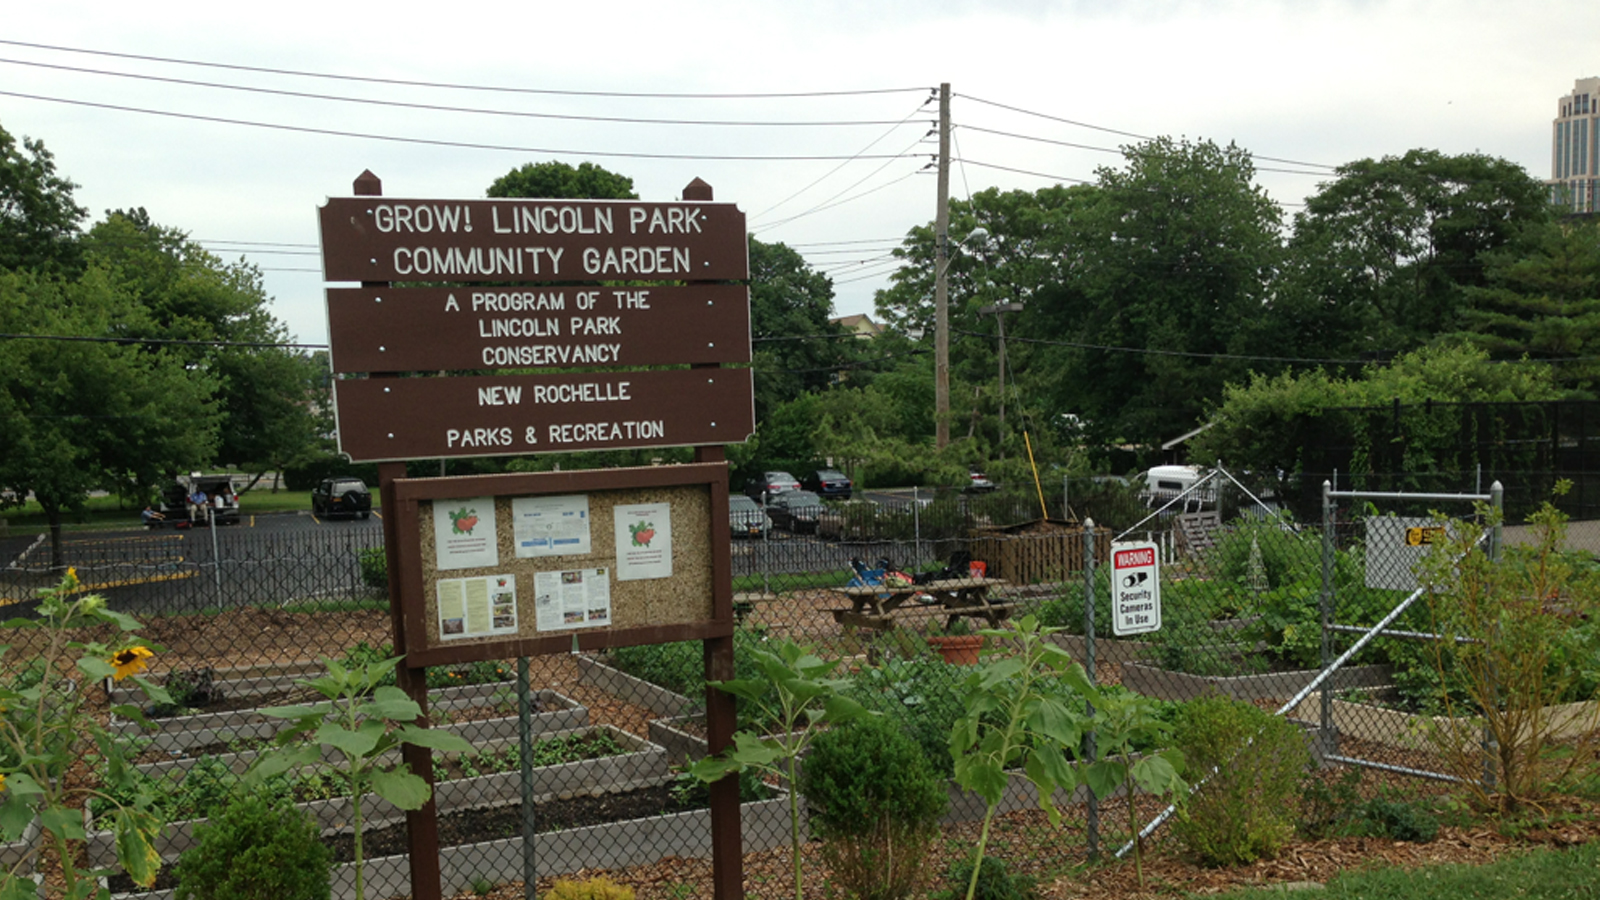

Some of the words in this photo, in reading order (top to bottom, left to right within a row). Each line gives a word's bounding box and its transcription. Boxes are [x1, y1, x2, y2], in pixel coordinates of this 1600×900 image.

[374, 205, 474, 234] GROW!
[492, 206, 613, 235] LINCOLN
[629, 207, 702, 235] PARK
[393, 246, 564, 275] COMMUNITY
[582, 246, 691, 275] GARDEN
[444, 293, 460, 312] A
[471, 292, 565, 312] PROGRAM
[576, 291, 601, 310] OF
[612, 290, 651, 309] THE
[478, 318, 559, 338] LINCOLN
[570, 316, 622, 336] PARK
[482, 343, 621, 366] CONSERVANCY
[478, 385, 522, 406] NEW
[534, 382, 632, 404] ROCHELLE
[446, 427, 513, 448] PARKS
[525, 426, 537, 445] &
[548, 420, 665, 443] RECREATION
[1118, 550, 1152, 566] WARNING
[1120, 590, 1152, 602] Security
[1120, 603, 1153, 614] Cameras
[1125, 615, 1133, 625] In
[1135, 614, 1149, 624] Use
